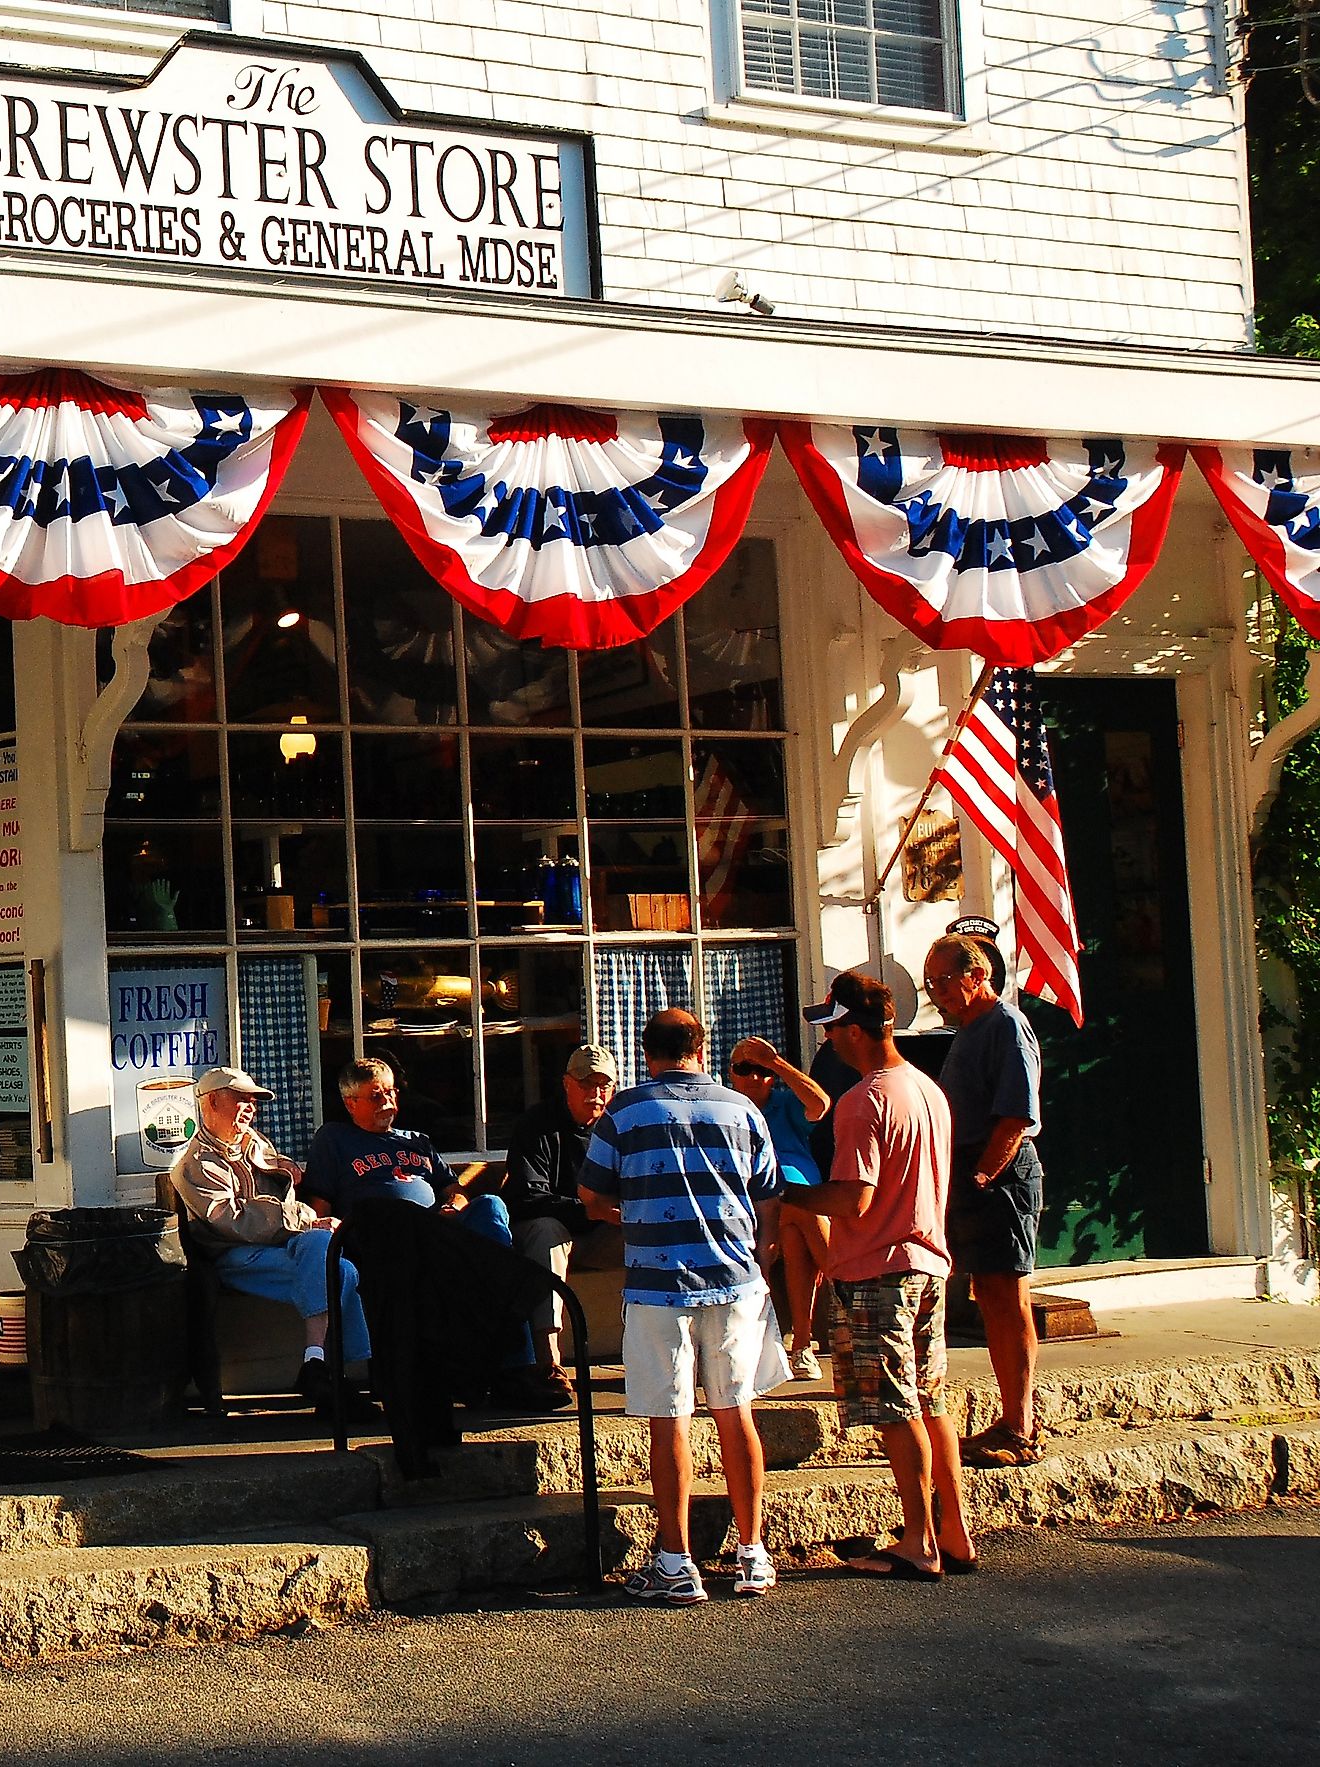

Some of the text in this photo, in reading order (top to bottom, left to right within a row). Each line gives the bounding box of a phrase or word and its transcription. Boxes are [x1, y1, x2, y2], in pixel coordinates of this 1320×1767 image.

[226, 65, 320, 115] The
[364, 134, 565, 231] STORE
[219, 211, 246, 261] &
[261, 215, 444, 279] GENERAL
[457, 234, 558, 290] MDSE
[3, 820, 20, 837] MU
[6, 881, 18, 891] the
[118, 983, 209, 1022] FRESH
[2, 1054, 18, 1063] AND
[111, 1030, 219, 1070] COFFEE
[13, 1094, 27, 1102] You!
[351, 1152, 393, 1177] RED
